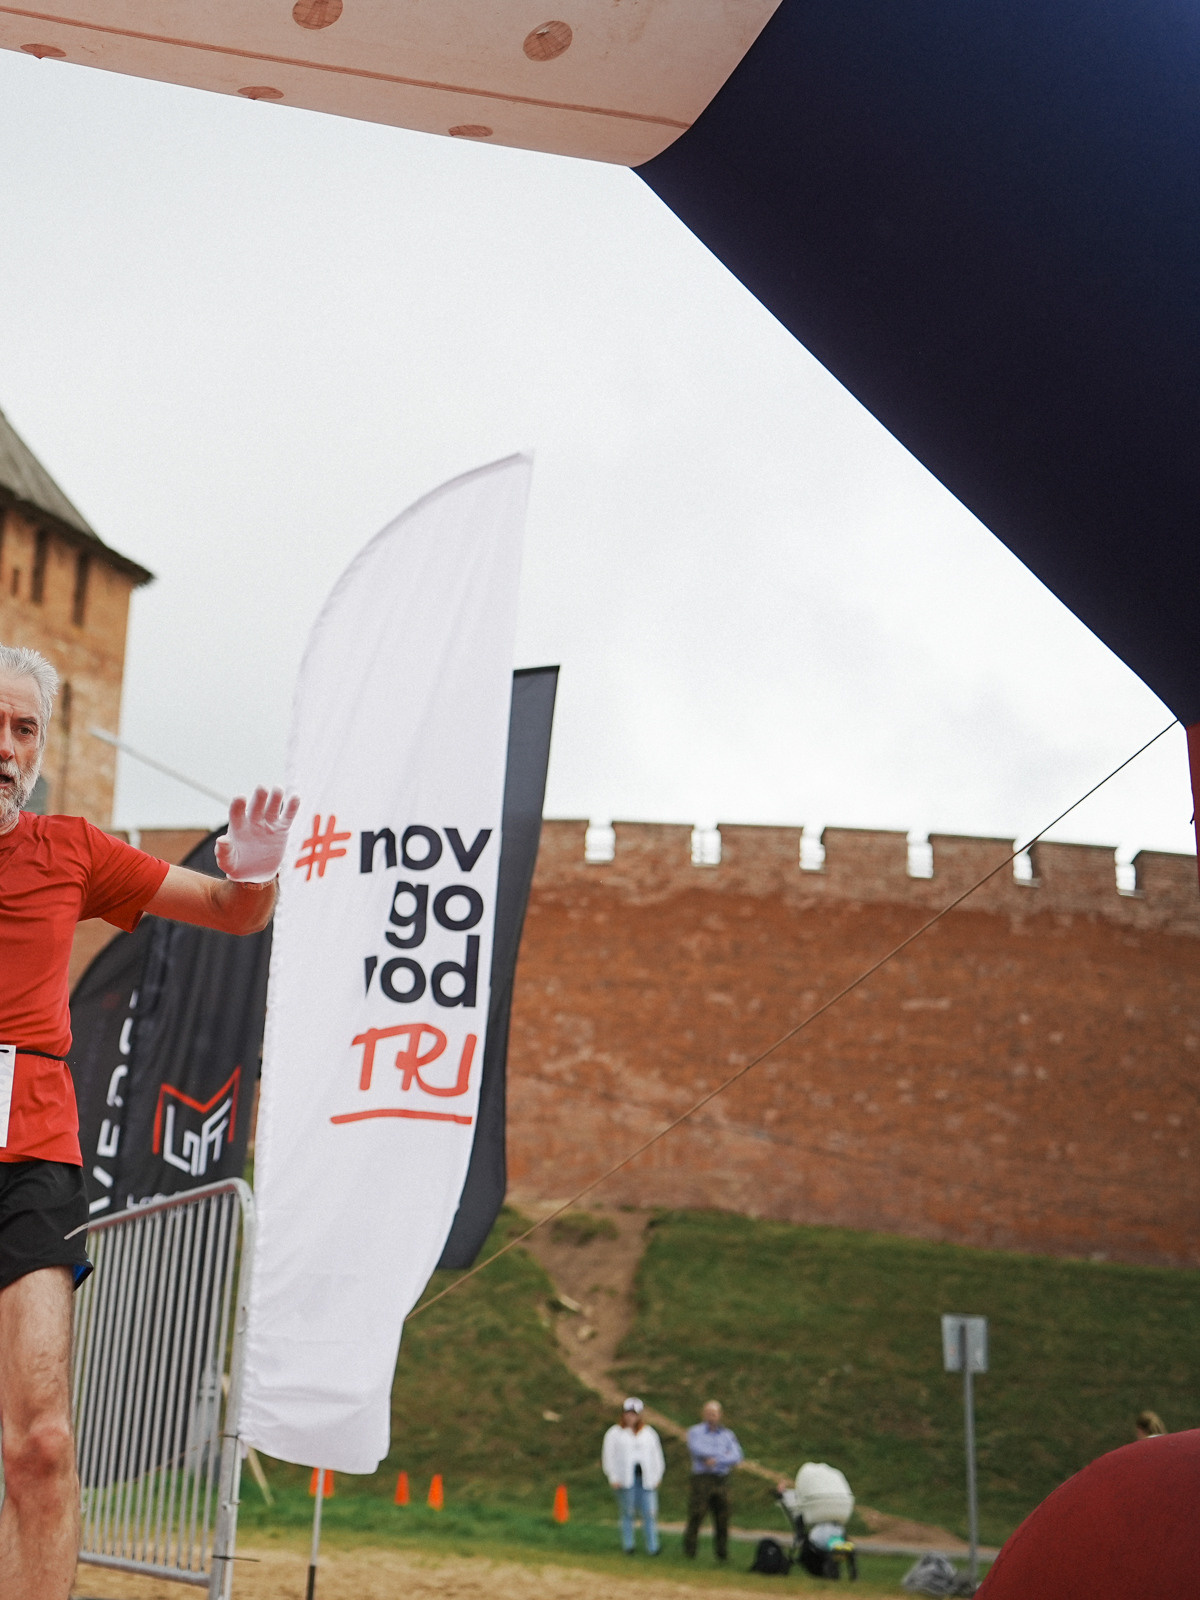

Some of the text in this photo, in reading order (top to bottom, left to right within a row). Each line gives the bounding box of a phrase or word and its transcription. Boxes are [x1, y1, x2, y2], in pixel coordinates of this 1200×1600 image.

[295, 814, 493, 882] #nov
[385, 880, 484, 949] go
[351, 1022, 478, 1098] TRI
